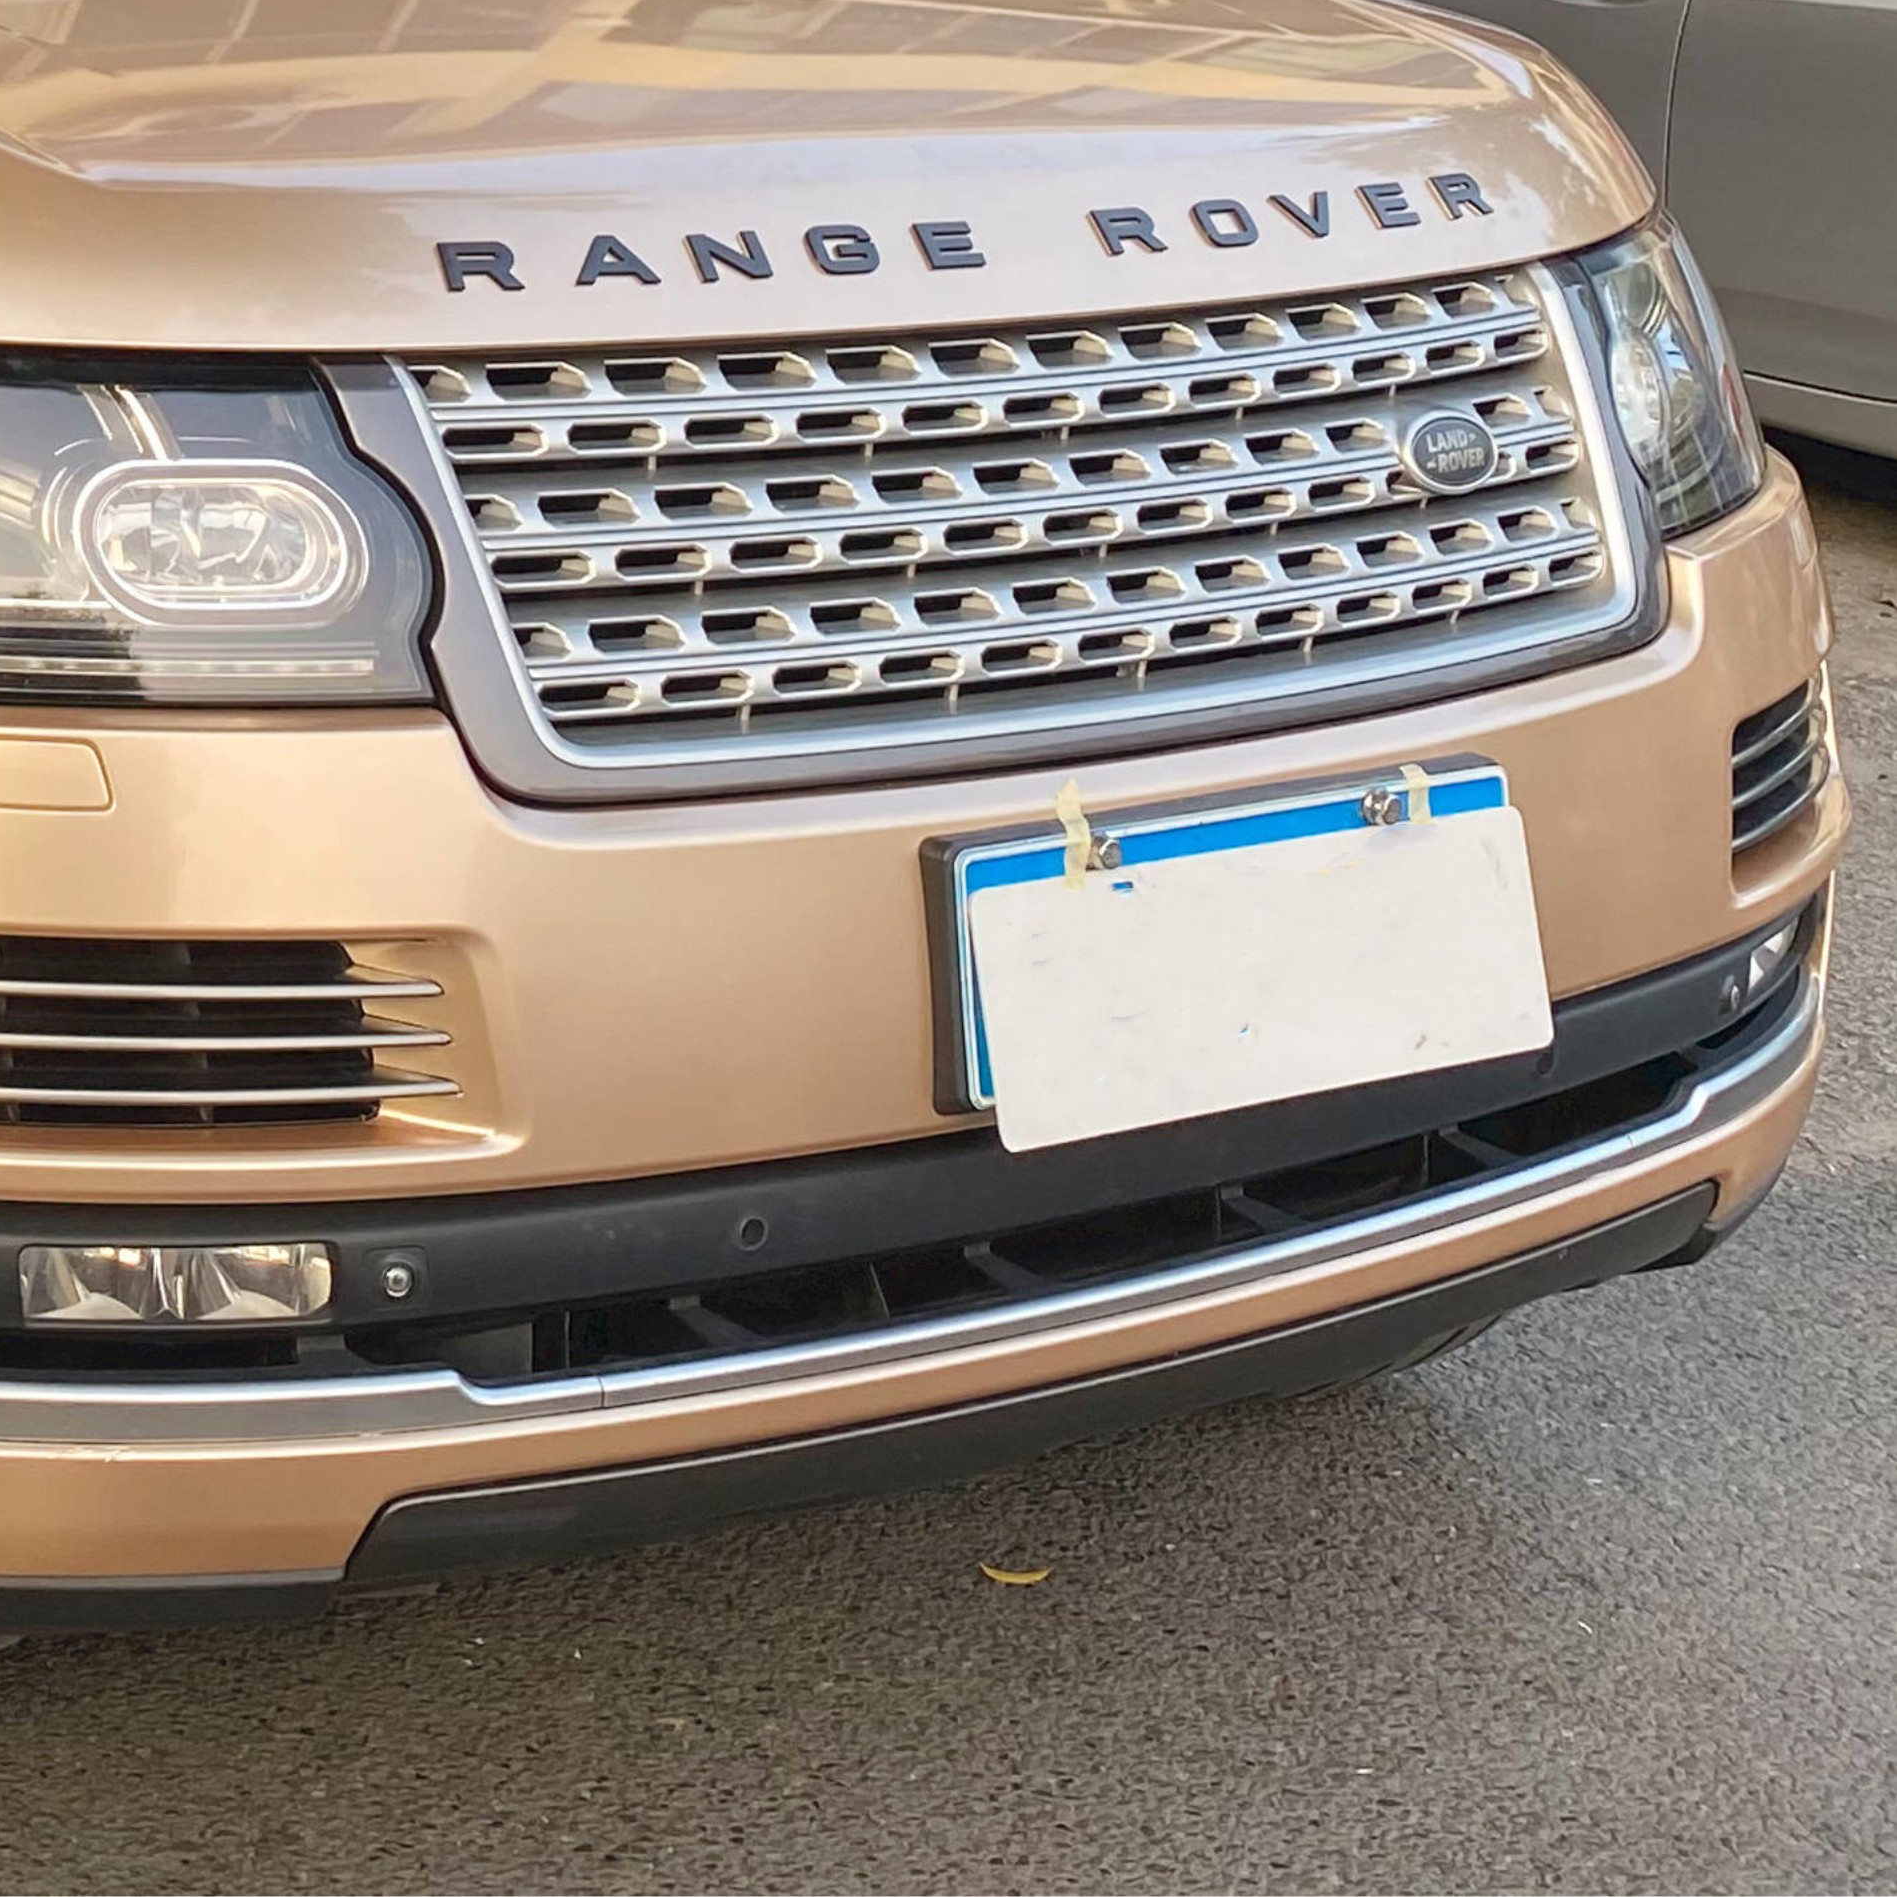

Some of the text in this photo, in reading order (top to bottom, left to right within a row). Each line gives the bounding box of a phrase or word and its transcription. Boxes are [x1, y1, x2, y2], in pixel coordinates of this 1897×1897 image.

[435, 169, 1496, 294] RANGE ROVER
[1426, 428, 1470, 453] LAND
[1438, 447, 1486, 474] ROVER
